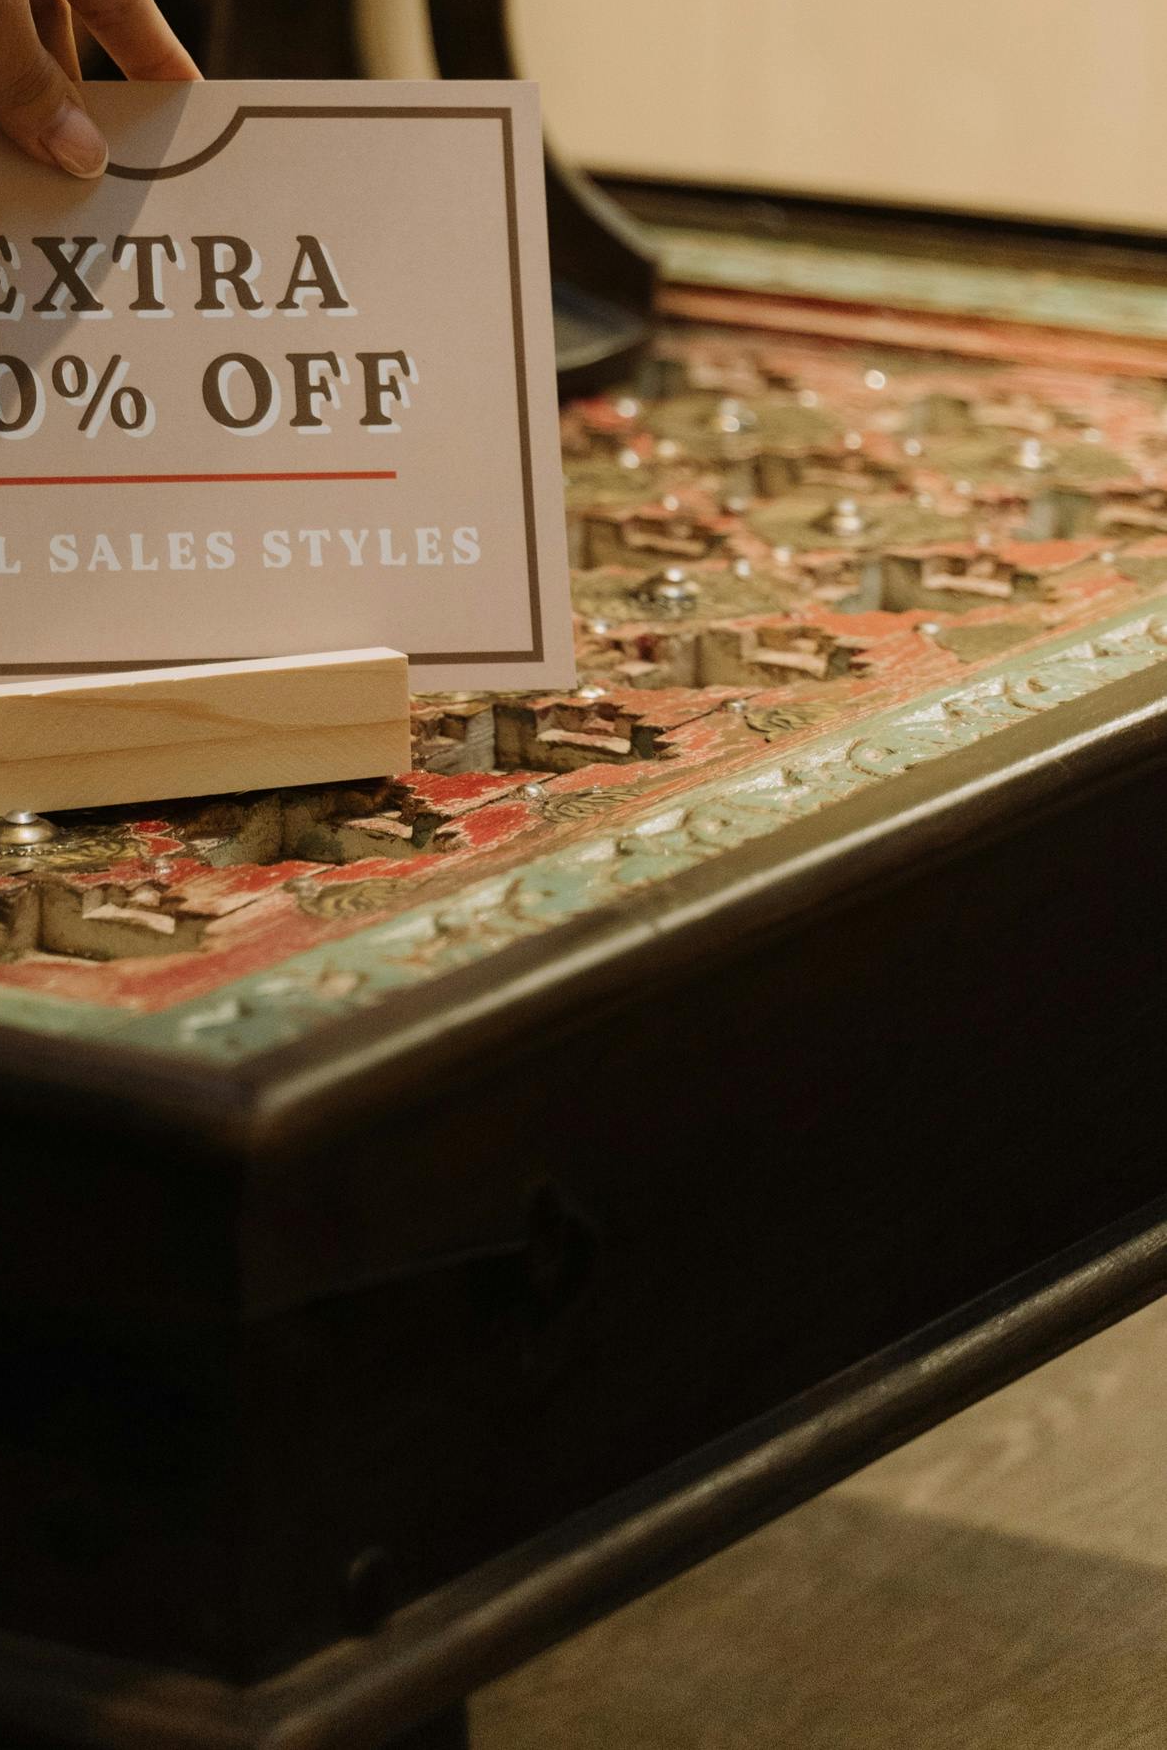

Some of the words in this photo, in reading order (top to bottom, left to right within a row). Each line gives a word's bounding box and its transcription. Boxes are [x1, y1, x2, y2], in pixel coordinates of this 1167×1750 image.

[201, 349, 420, 436] OFF
[48, 530, 236, 572] SALES
[261, 526, 482, 568] STYLES
